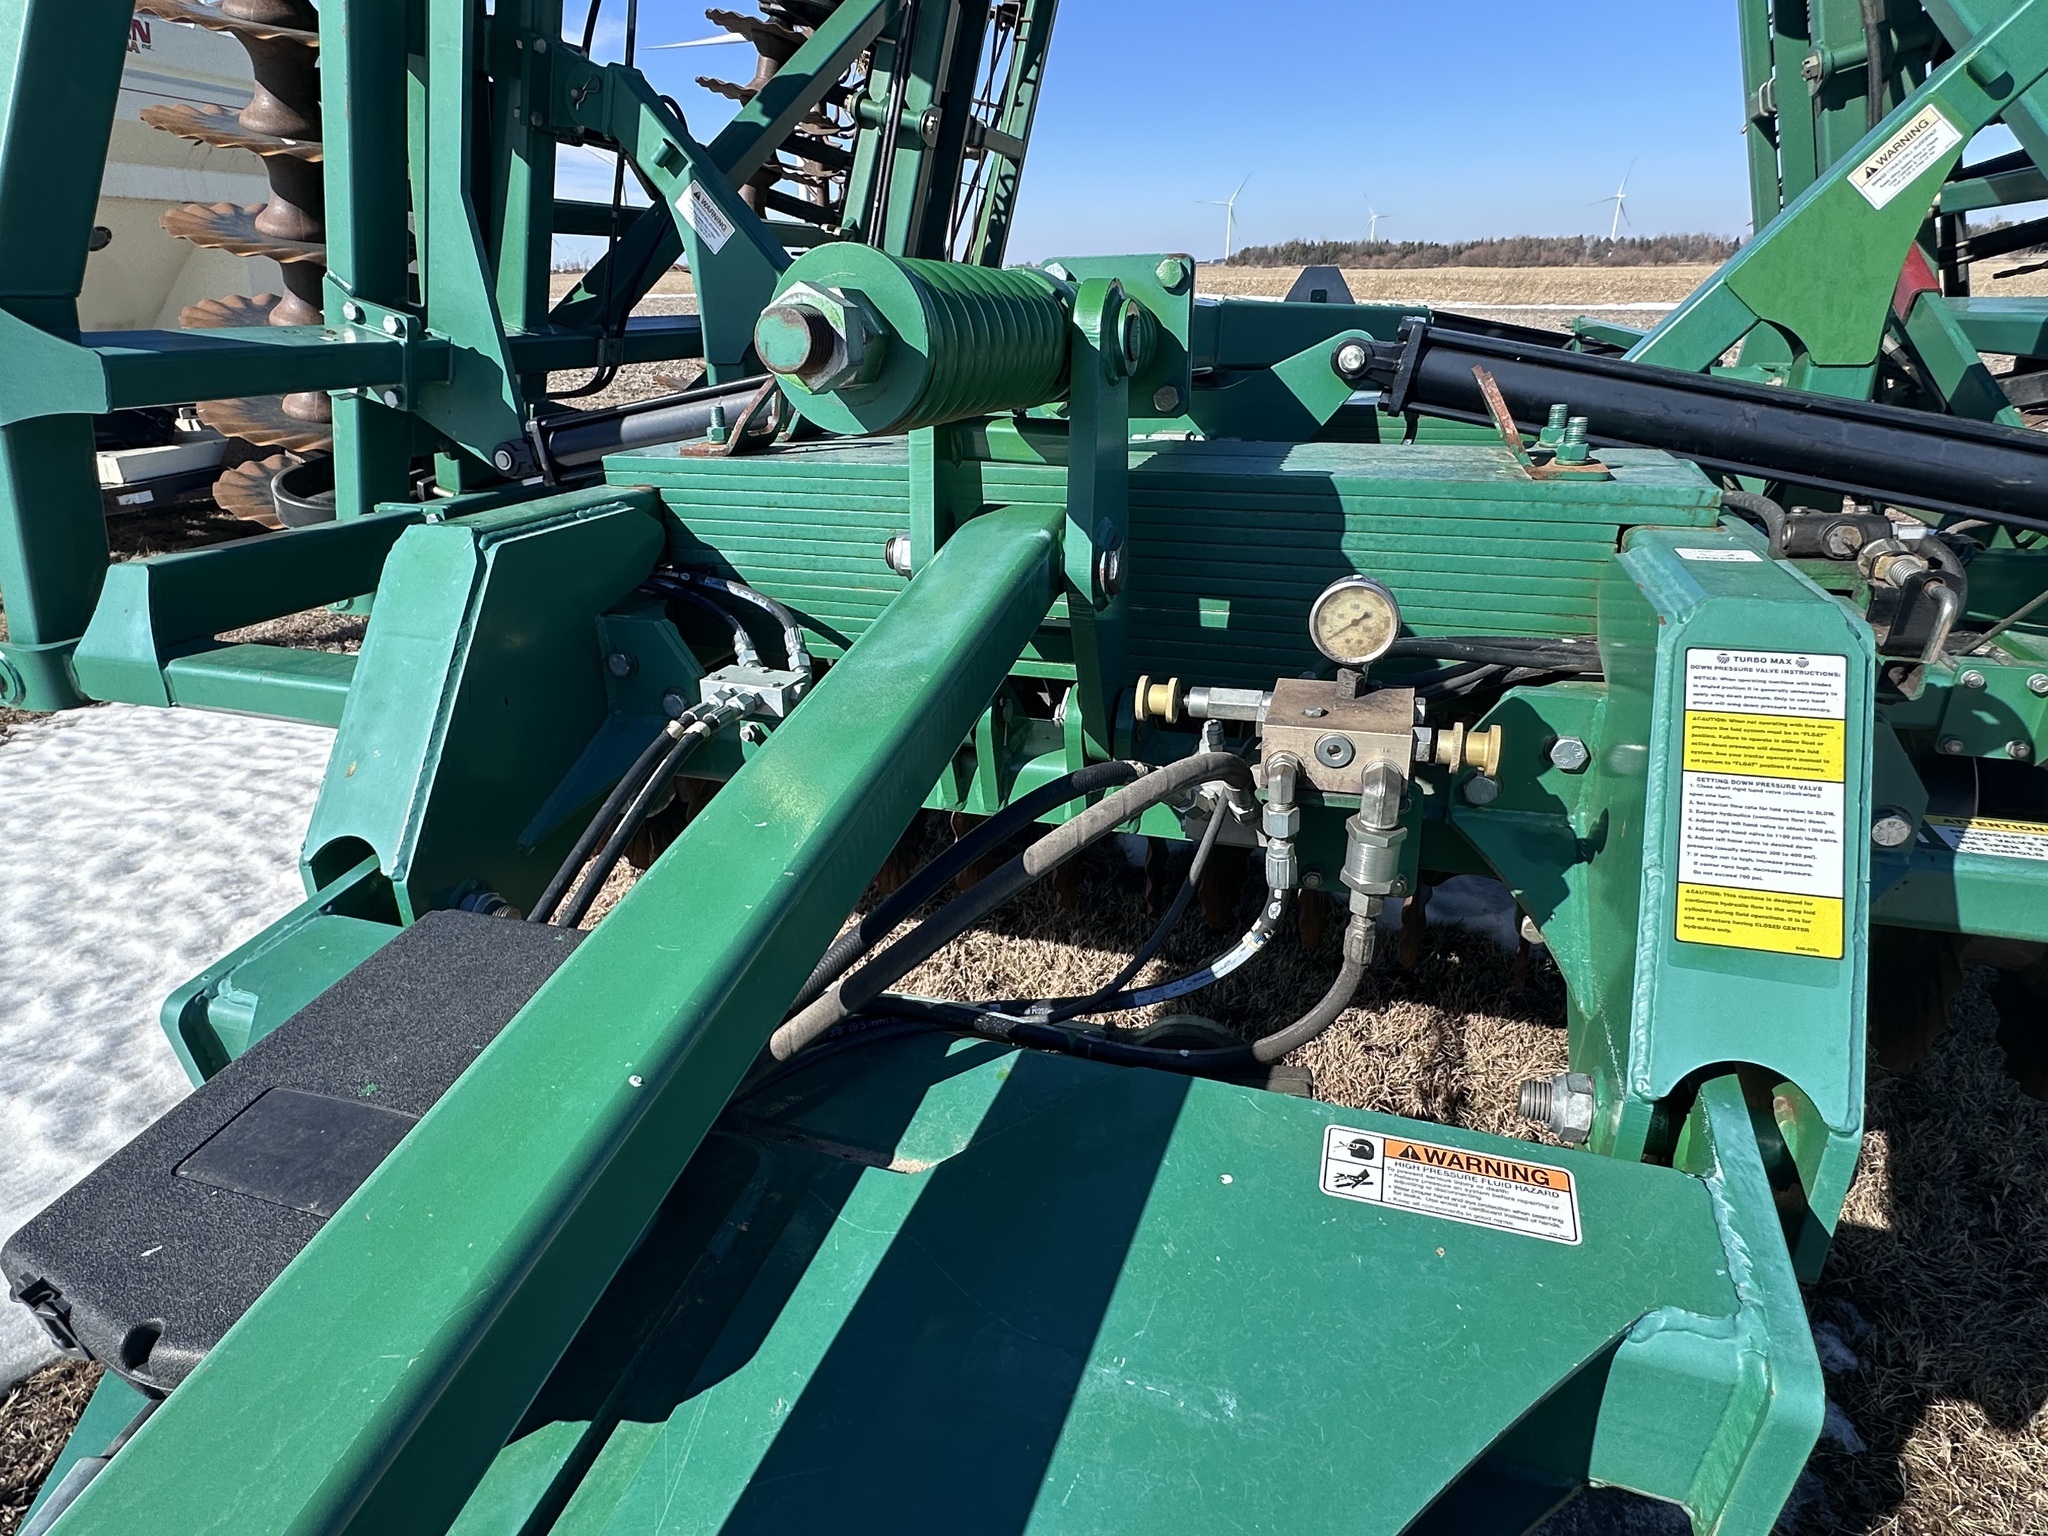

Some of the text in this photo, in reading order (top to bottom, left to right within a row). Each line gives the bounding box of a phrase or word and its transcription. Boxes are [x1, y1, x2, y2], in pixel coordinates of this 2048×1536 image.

[1875, 119, 1930, 166] WARNING
[700, 198, 728, 232] WARNING
[1733, 655, 1767, 664] TURBO
[1781, 668, 1841, 677] INSTRUCTIONS:
[1696, 776, 1728, 784] SETTING
[1755, 780, 1796, 789] PRESSURE
[1394, 1159, 1559, 1199] HIGH PRESSURE FLUID HAZARD
[1422, 1146, 1550, 1186] WARNING
